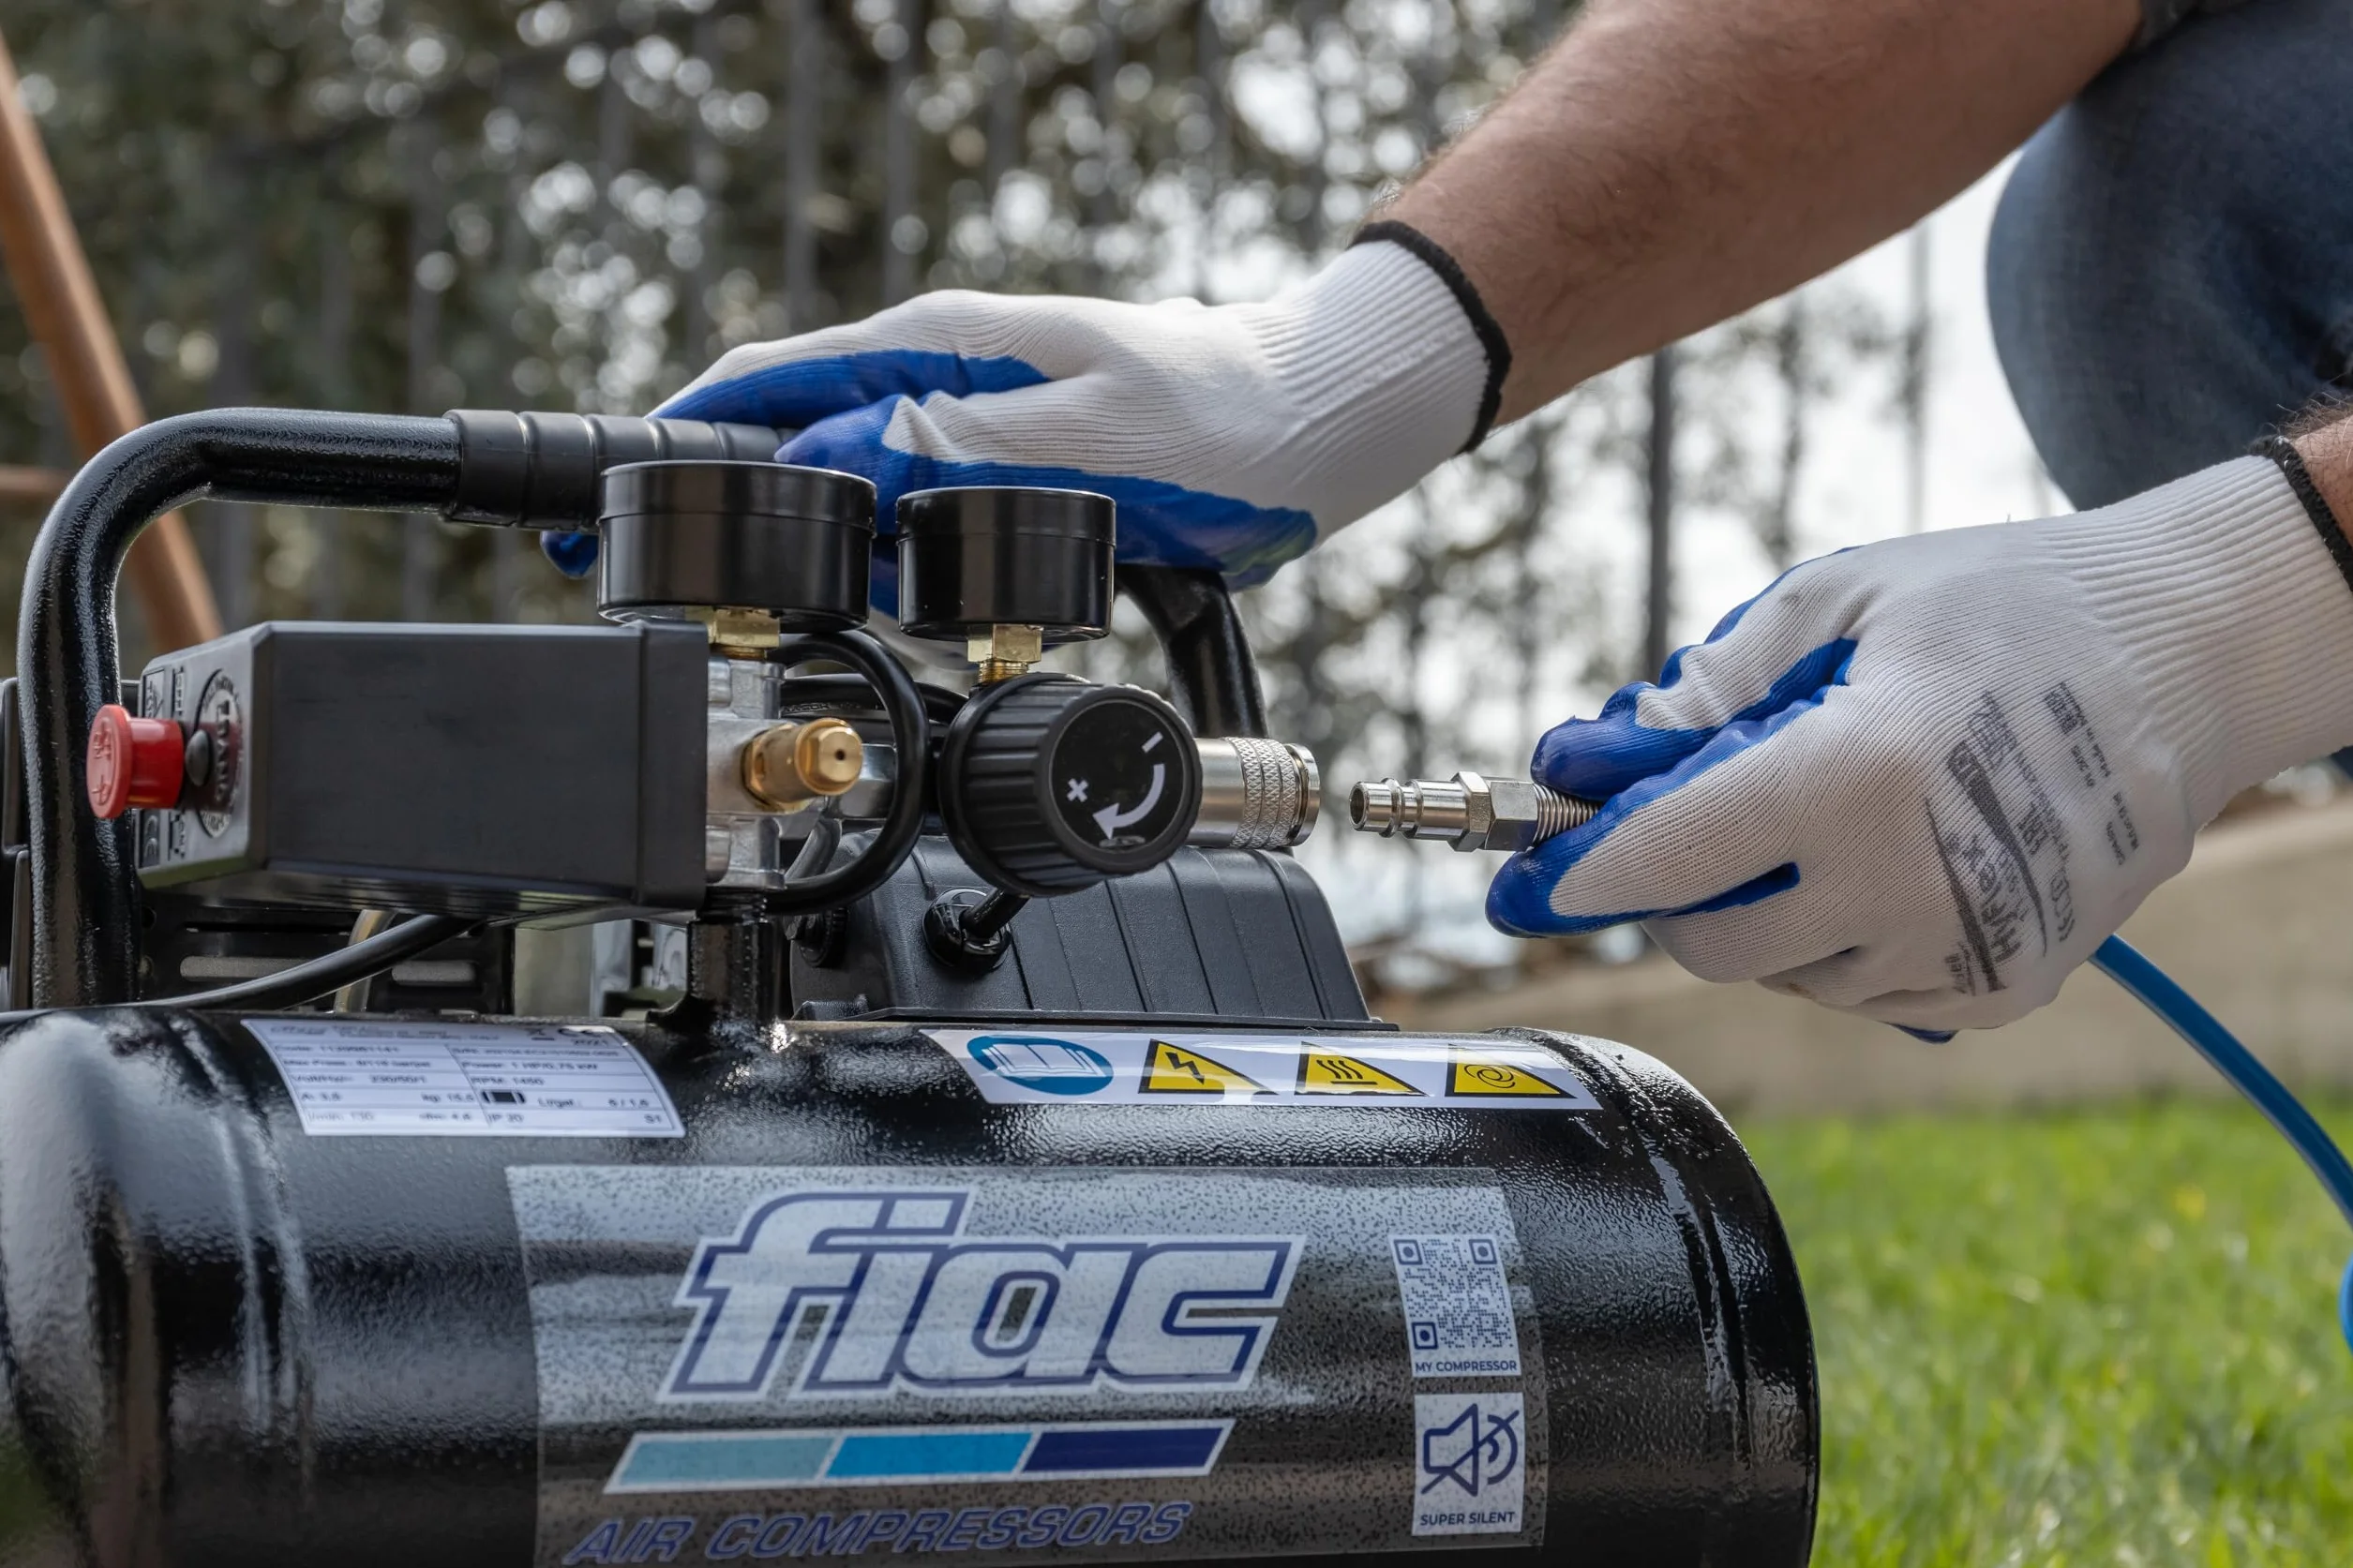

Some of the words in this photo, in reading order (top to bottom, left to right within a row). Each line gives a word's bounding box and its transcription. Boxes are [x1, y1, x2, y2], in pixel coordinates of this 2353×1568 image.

[659, 1185, 1306, 1402] fiac
[1415, 1362, 1432, 1373] MY
[1435, 1360, 1518, 1373] COMPRESSOR
[563, 1516, 692, 1566] AIR
[703, 1500, 1194, 1559] COMPRESSORS
[1419, 1513, 1466, 1527] SUPER
[1468, 1511, 1516, 1525] SILENT
